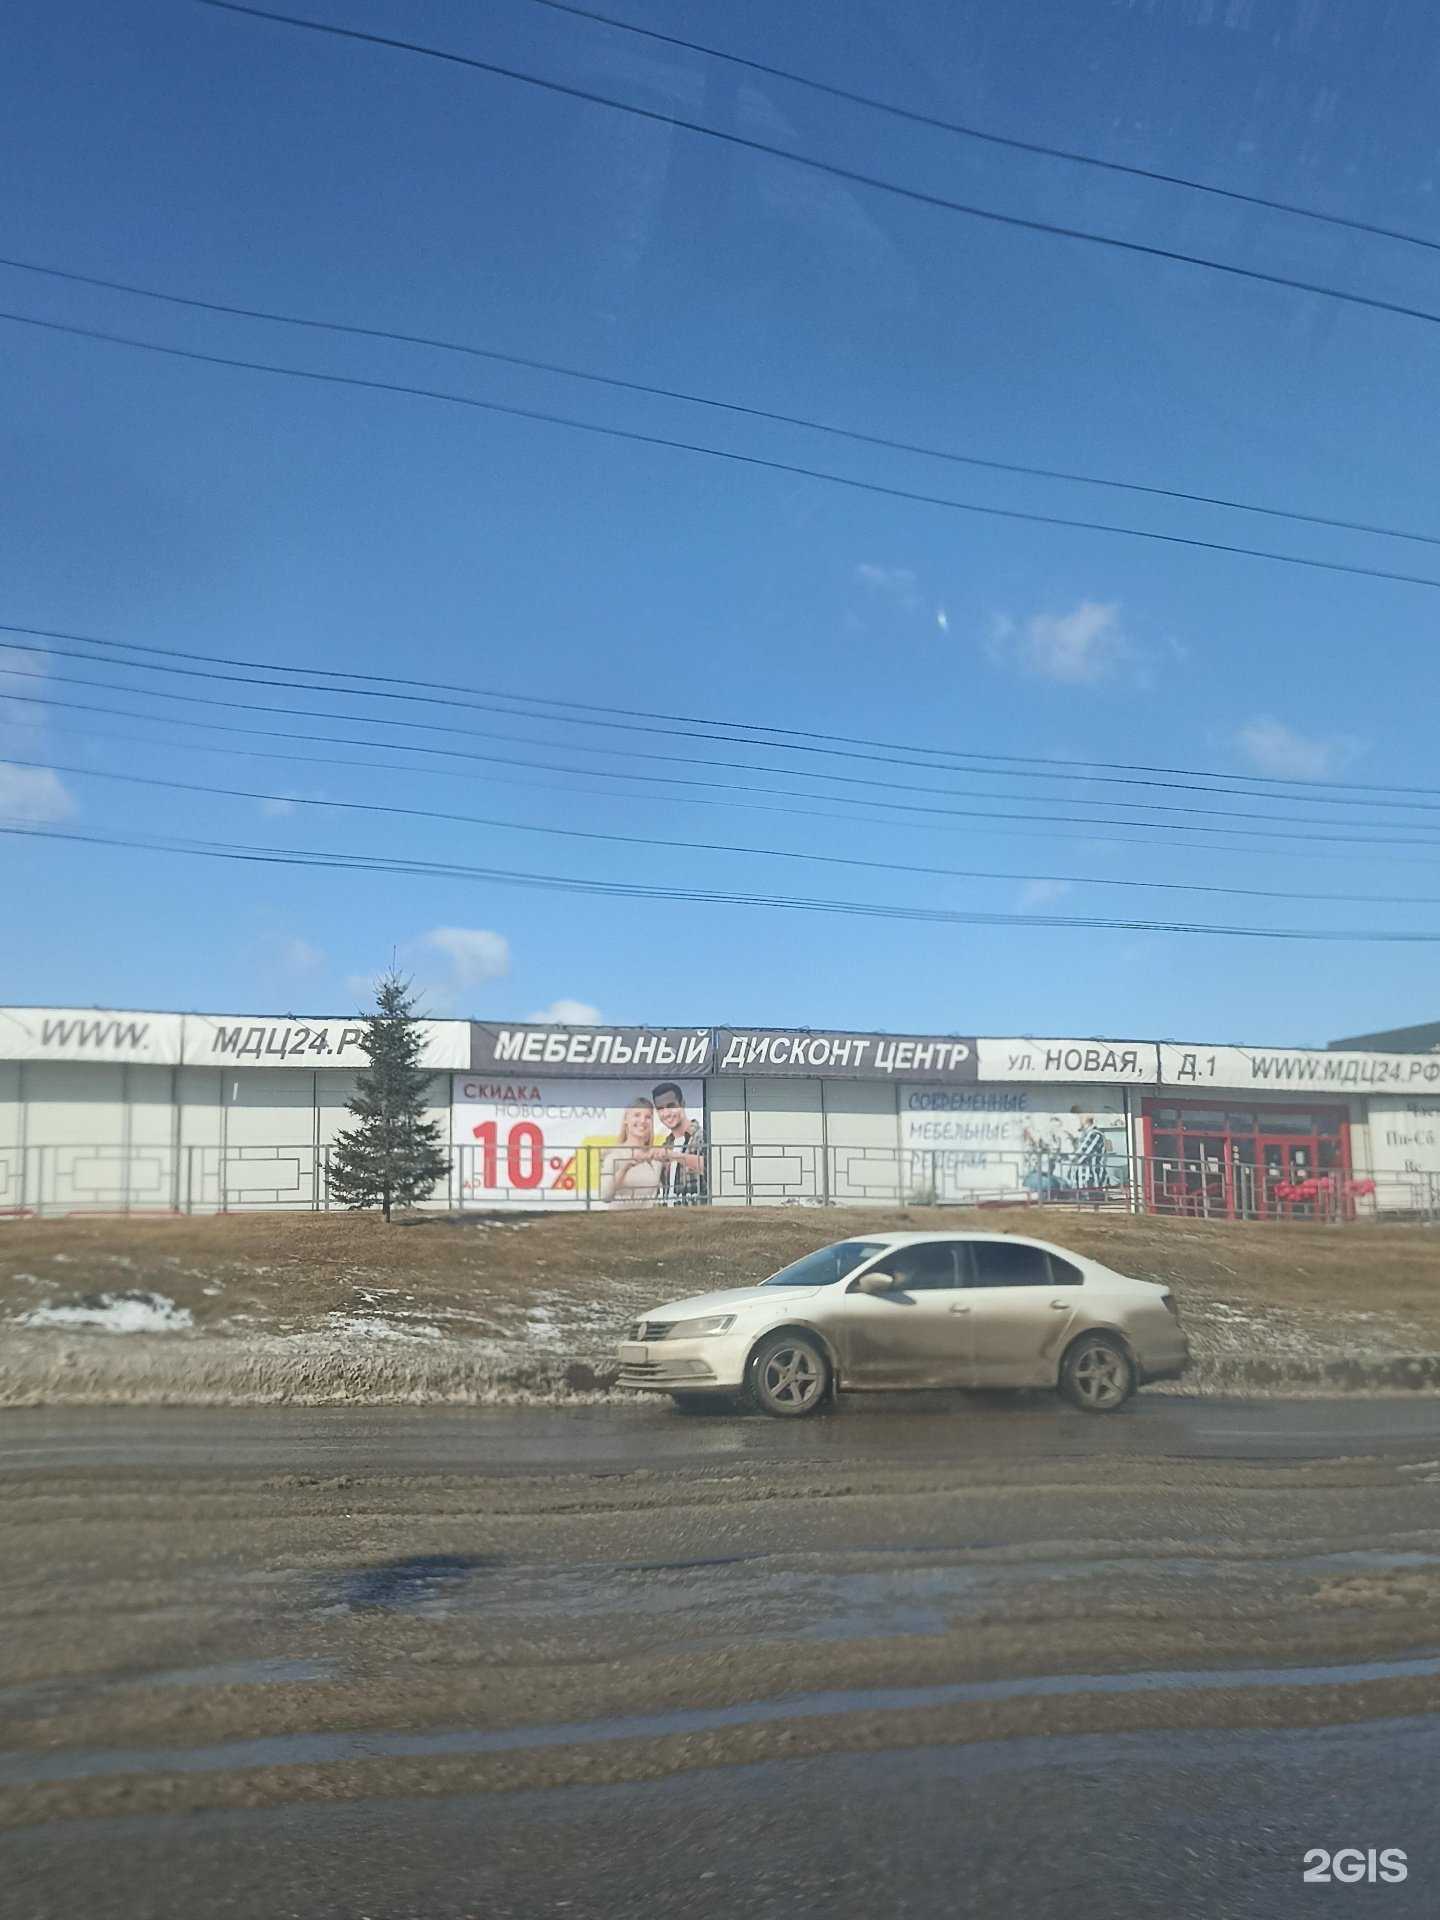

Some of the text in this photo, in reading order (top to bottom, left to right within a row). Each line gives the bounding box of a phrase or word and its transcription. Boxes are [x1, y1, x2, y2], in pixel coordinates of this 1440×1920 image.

[41, 1018, 151, 1051] WWW.
[211, 1025, 385, 1059] МДЦ24.Р
[493, 1030, 969, 1073] МЕБЕЛЬНЫЙ ДИСКОНТ ЦЕНТР
[1044, 1048, 1144, 1077] НОВАЯ,
[463, 1082, 542, 1101] СКИДКА
[495, 1104, 608, 1120] НОВОСЕЛАМ
[910, 1122, 1011, 1141] МЕБЕЛЬНЫЕ
